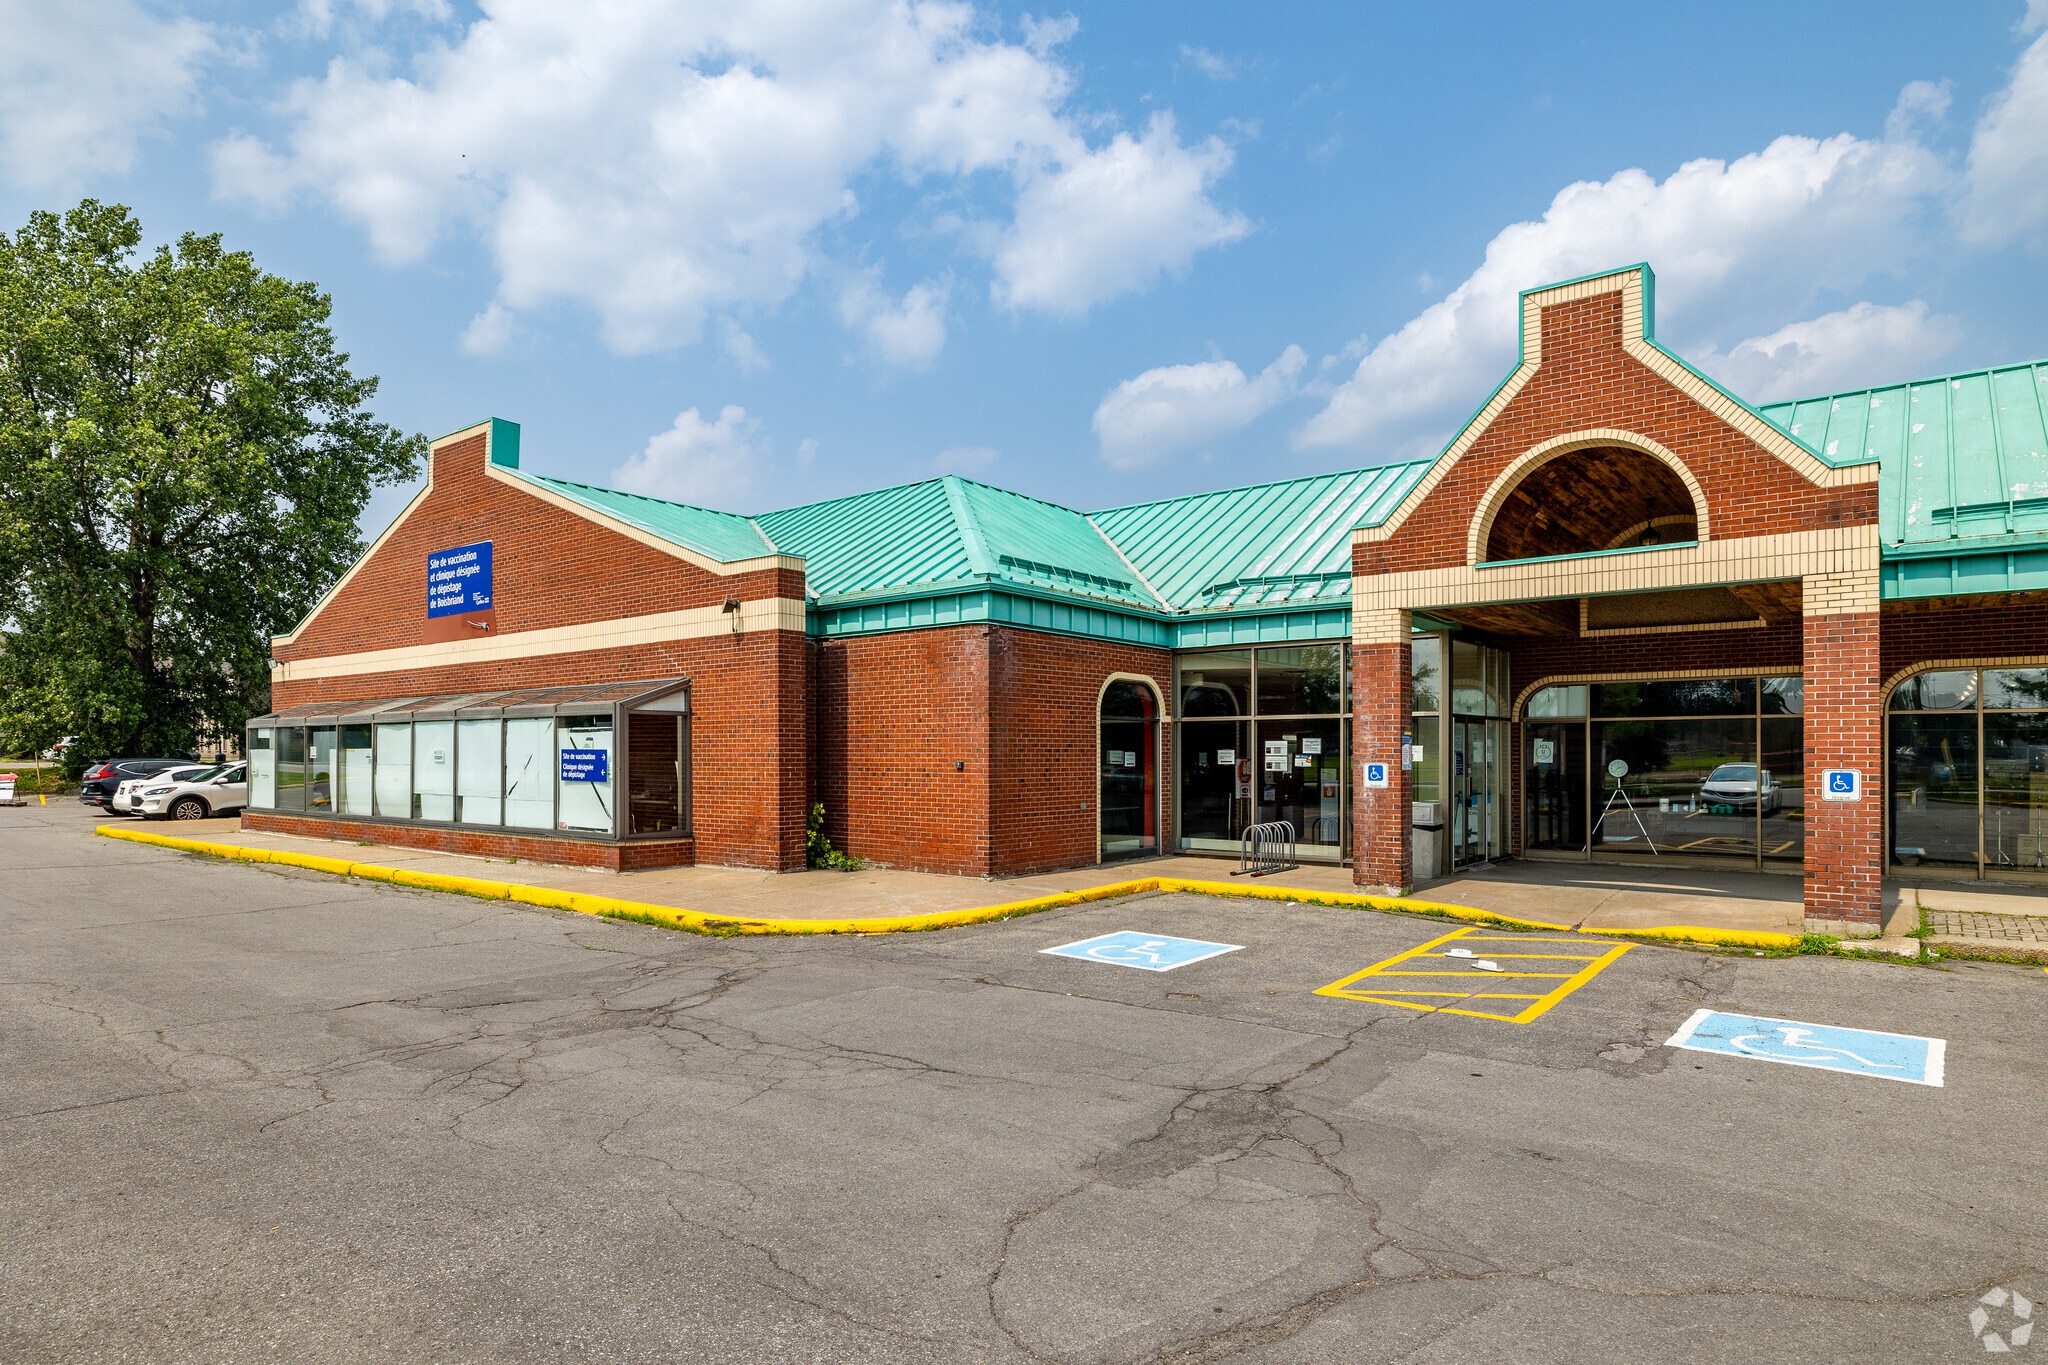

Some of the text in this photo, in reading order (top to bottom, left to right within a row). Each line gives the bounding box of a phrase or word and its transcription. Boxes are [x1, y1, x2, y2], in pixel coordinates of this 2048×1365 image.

[430, 551, 477, 569] Site de vaccination
[430, 563, 480, 582] et clinique désignée
[430, 582, 462, 596] de dépistage
[430, 599, 437, 609] de
[437, 593, 464, 608] Boisbriand
